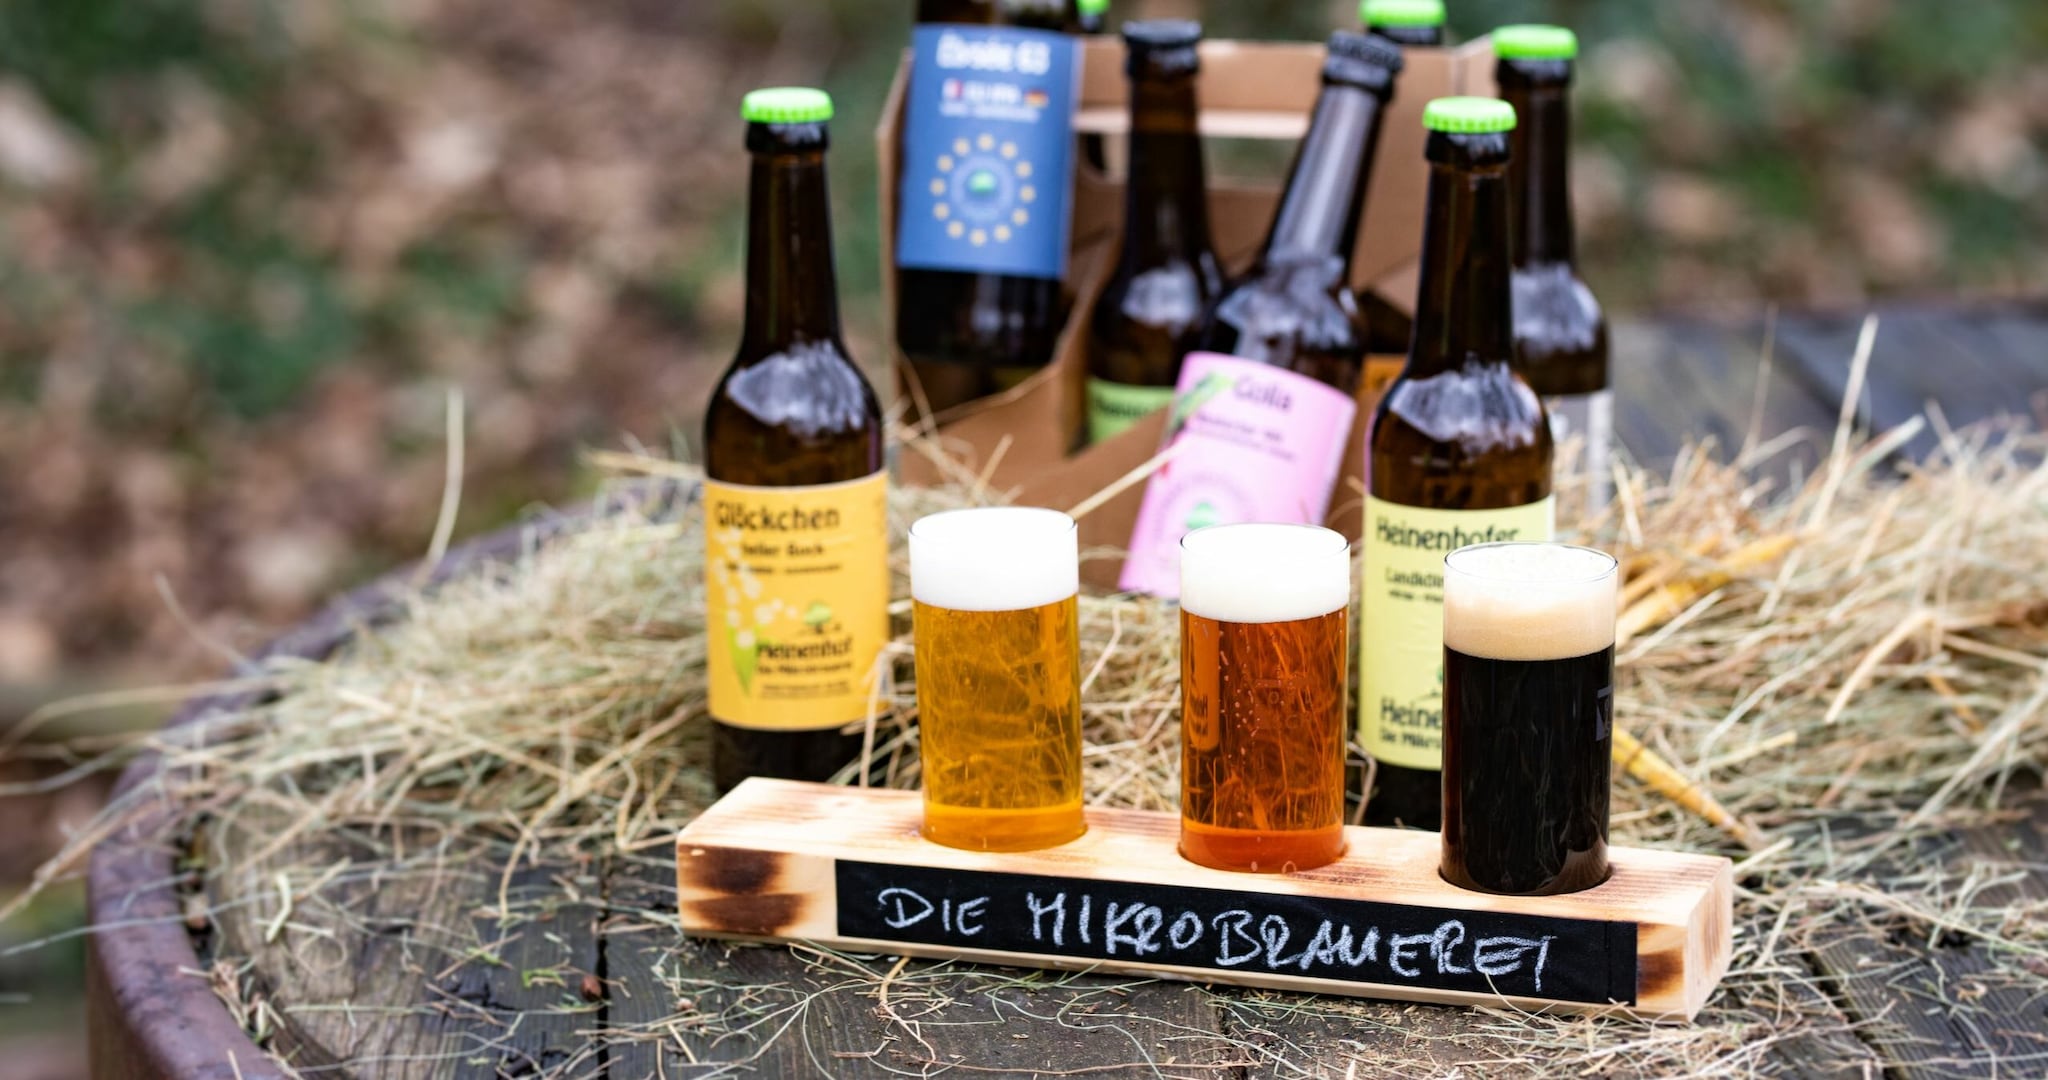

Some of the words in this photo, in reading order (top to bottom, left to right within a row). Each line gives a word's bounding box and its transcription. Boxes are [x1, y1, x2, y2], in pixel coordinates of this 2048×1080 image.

[714, 501, 840, 531] Glöckchen
[1377, 515, 1519, 551] Heinenhofer
[878, 888, 989, 935] DIE
